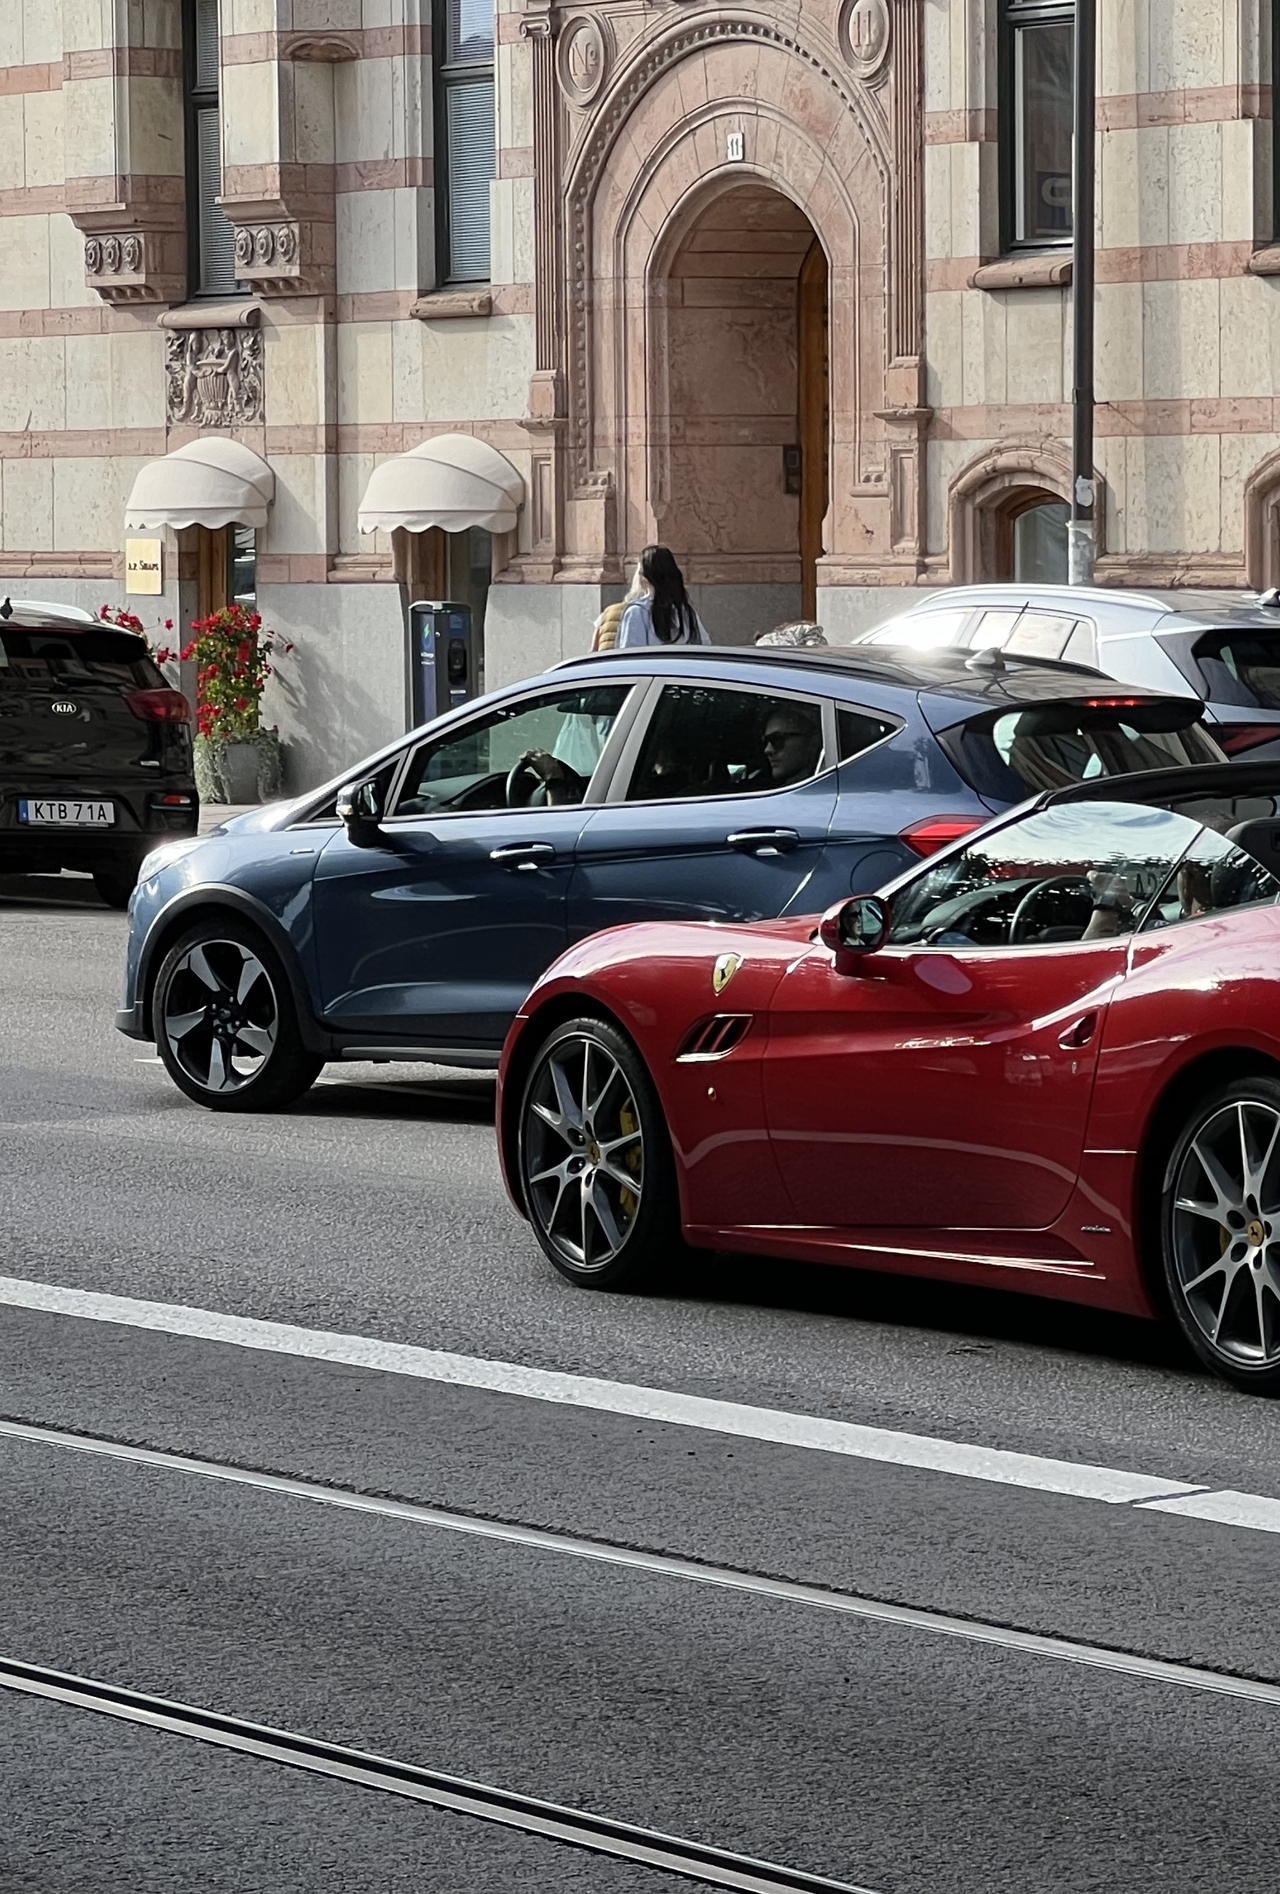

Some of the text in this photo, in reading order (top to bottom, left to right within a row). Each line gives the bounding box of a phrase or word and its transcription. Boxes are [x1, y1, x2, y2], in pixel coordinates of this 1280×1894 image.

[56, 703, 74, 713] KIA
[34, 802, 107, 820] KTB 71A
